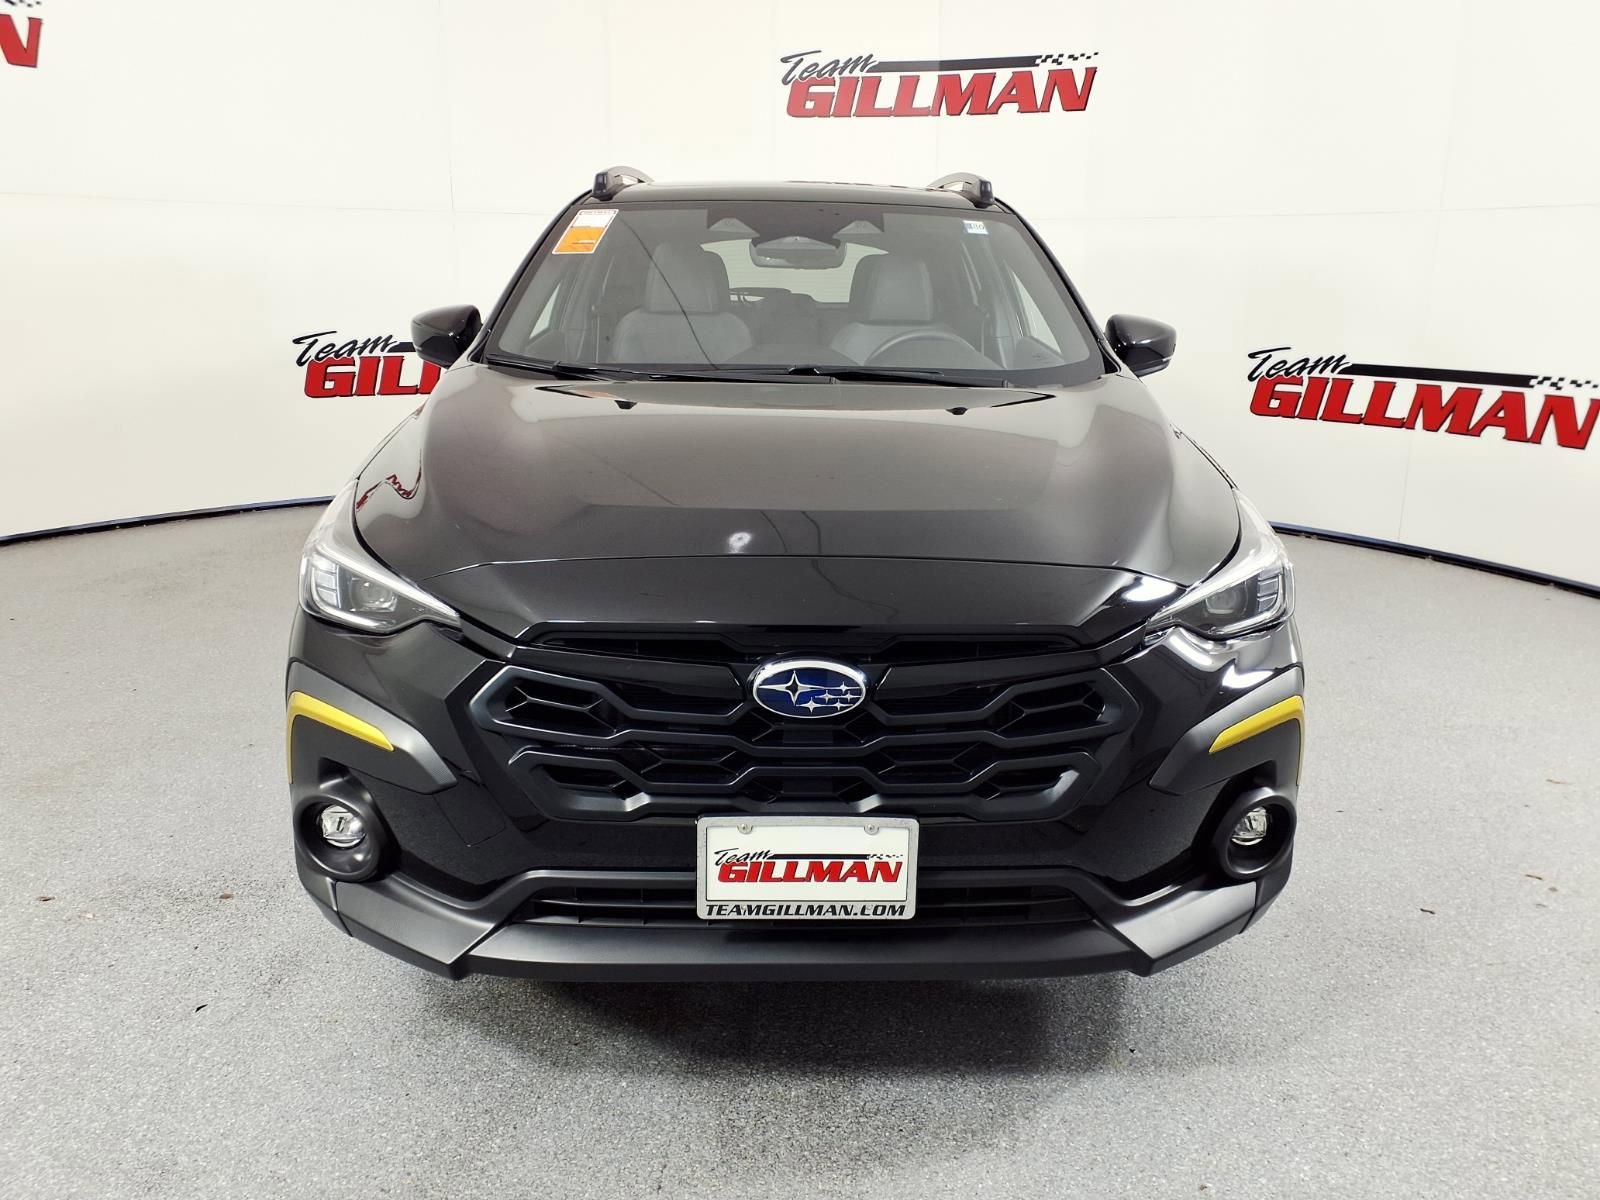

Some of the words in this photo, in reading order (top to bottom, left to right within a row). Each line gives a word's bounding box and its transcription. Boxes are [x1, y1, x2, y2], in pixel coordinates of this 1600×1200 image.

[780, 50, 874, 85] Team
[786, 67, 1098, 118] GILLMAN
[292, 330, 397, 367] Team
[1247, 346, 1348, 382] Team
[1249, 375, 1600, 450] GILLMAN
[714, 847, 771, 867] Team
[718, 861, 903, 883] GILLMAN
[706, 904, 906, 917] TEAMGILLMAN.COM
